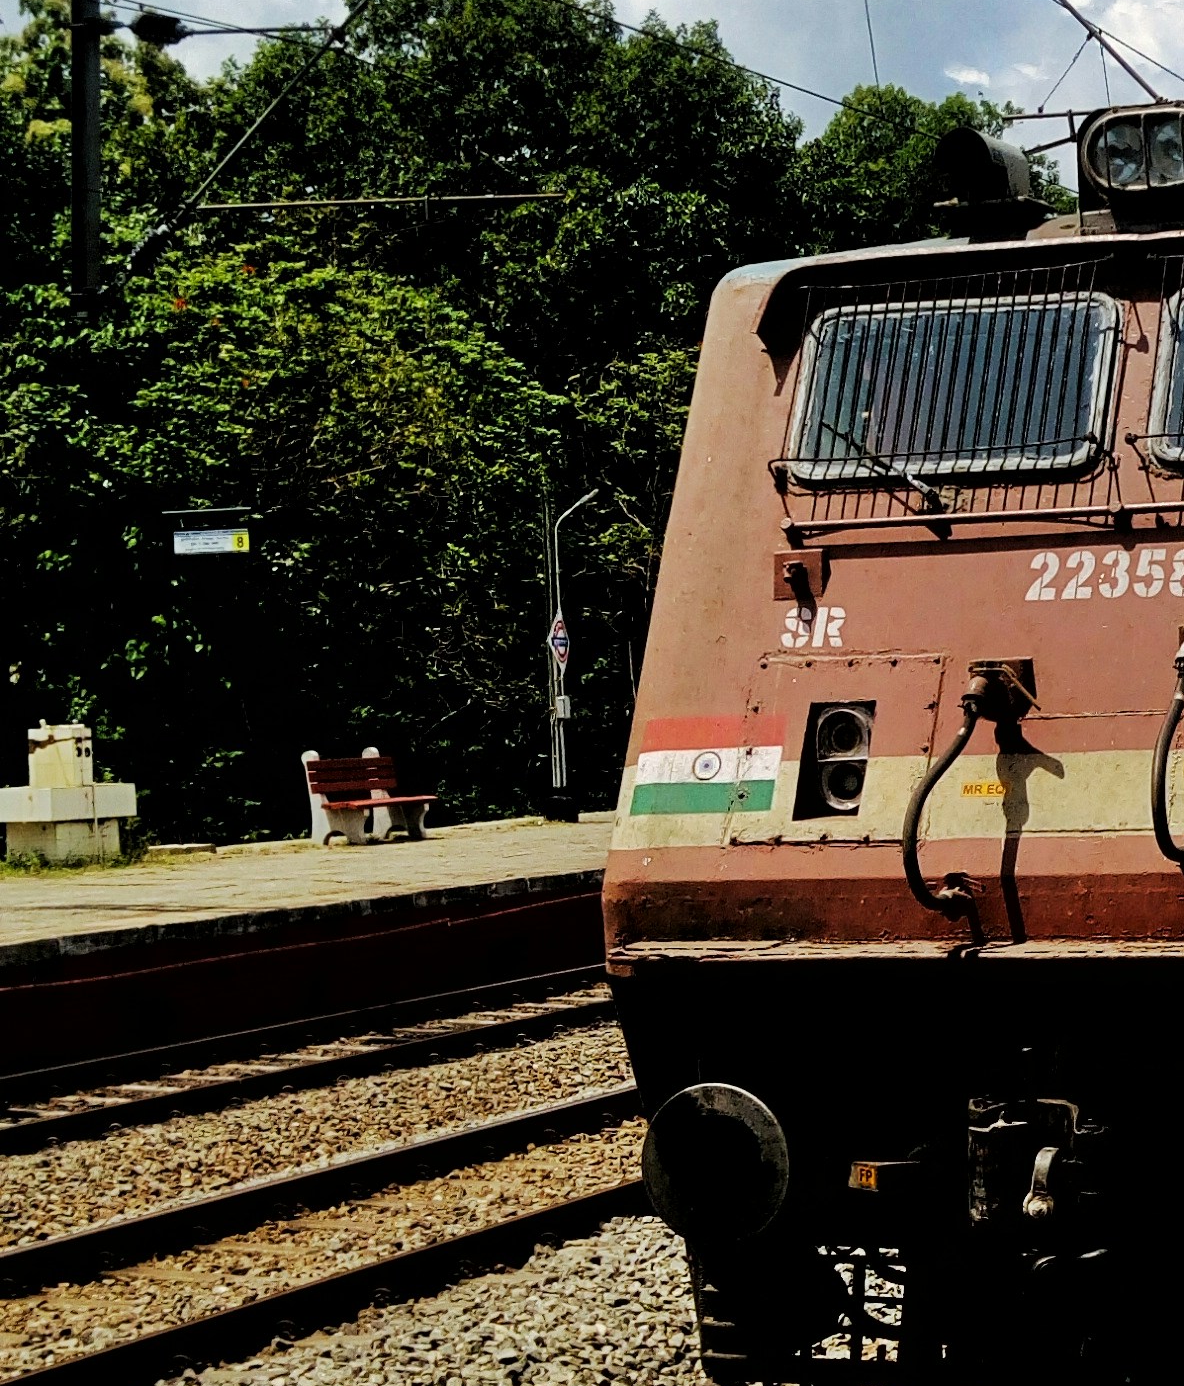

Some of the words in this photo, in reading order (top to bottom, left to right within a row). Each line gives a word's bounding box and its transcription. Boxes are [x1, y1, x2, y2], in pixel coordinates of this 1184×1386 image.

[237, 536, 244, 548] 8
[780, 606, 846, 648] SR
[962, 784, 983, 795] MR
[859, 1168, 873, 1183] FP
